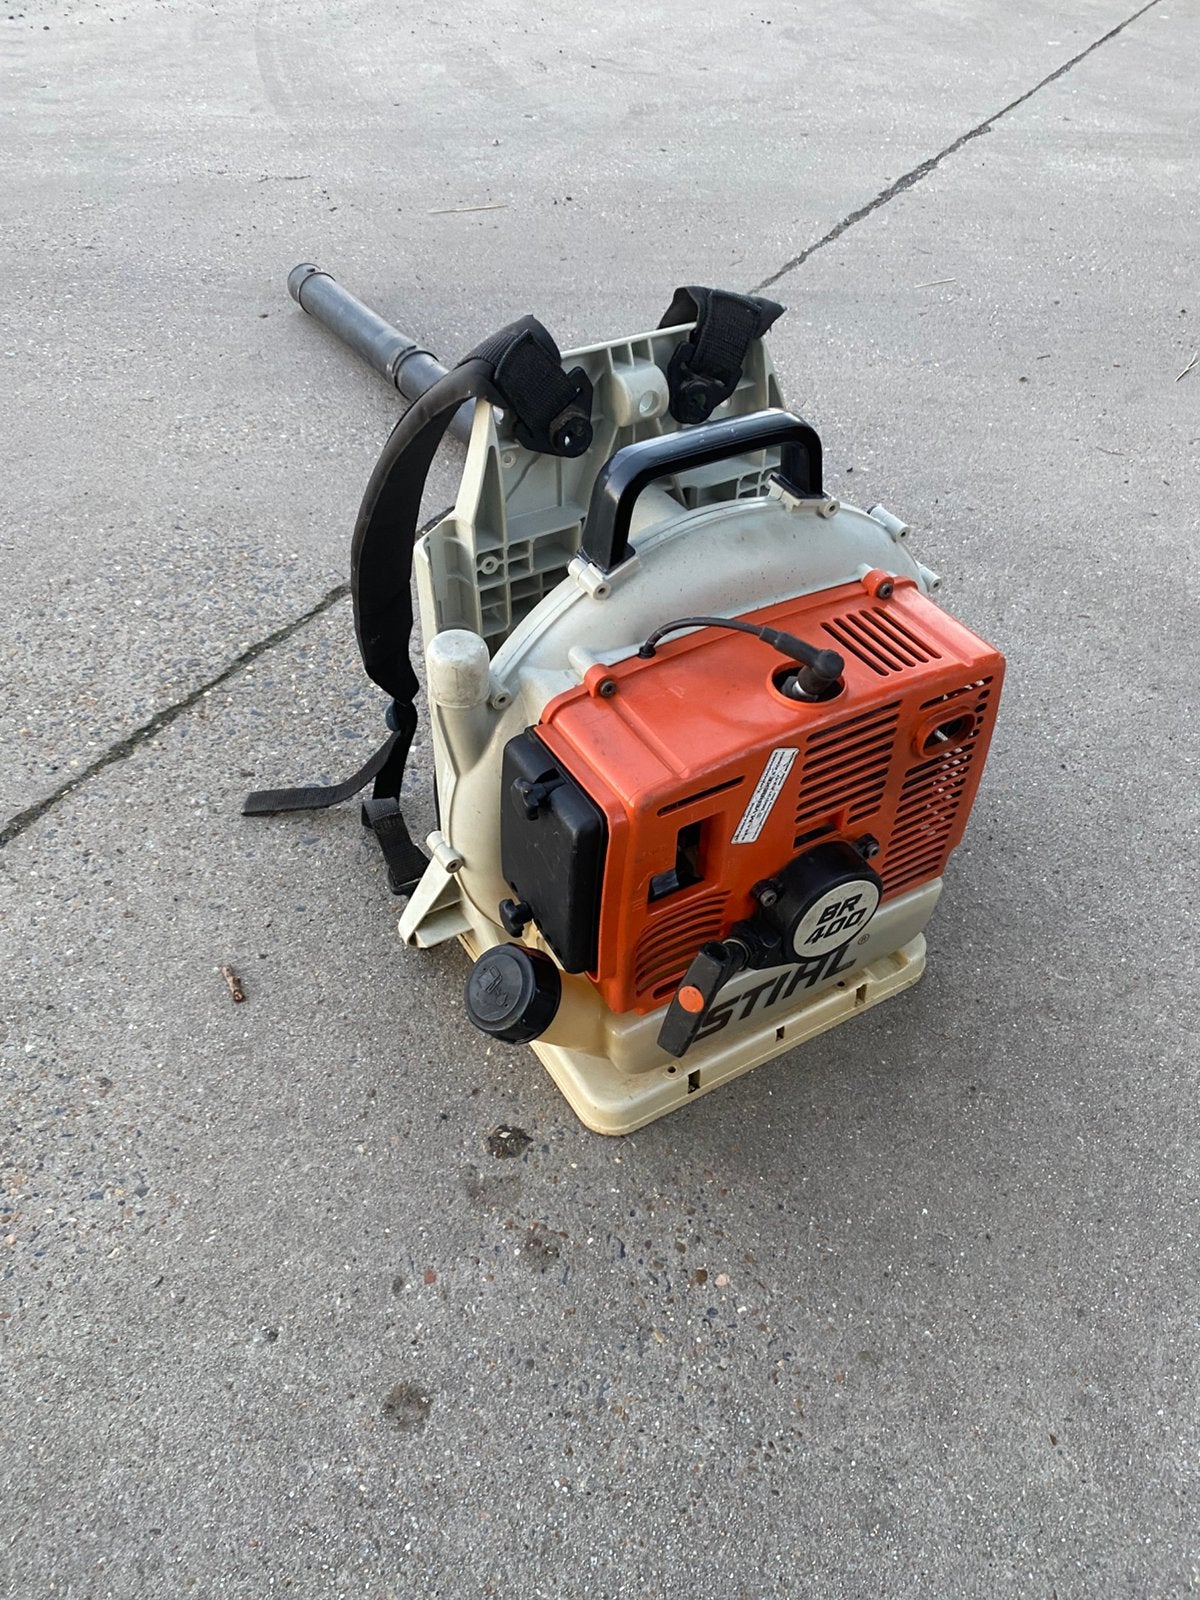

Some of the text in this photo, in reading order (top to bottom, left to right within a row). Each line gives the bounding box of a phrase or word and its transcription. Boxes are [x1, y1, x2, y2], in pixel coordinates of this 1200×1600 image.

[804, 907, 867, 945] 400
[816, 893, 863, 926] BR
[691, 944, 857, 1042] STIHL
